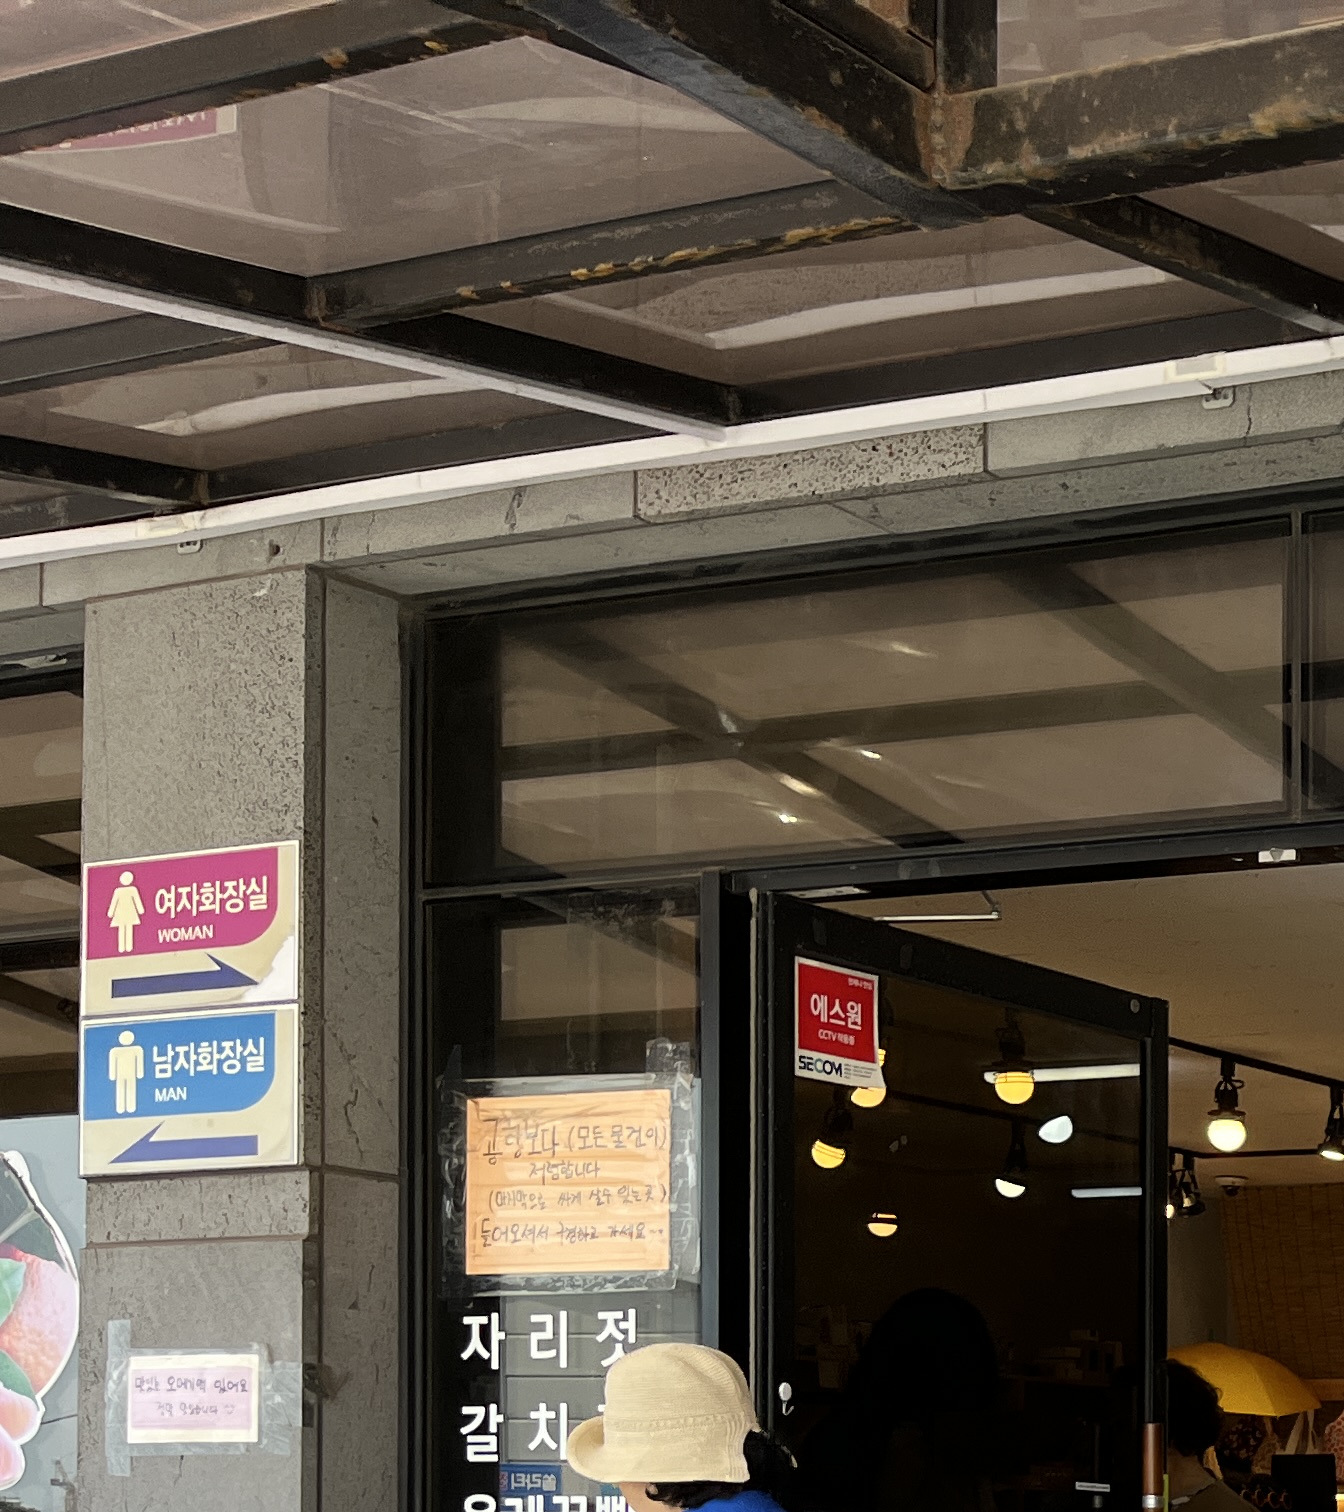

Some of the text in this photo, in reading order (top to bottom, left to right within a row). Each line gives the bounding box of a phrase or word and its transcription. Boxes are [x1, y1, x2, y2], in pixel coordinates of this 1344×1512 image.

[155, 876, 268, 919] 여자화장실
[158, 925, 214, 943] WOMAN
[810, 993, 862, 1031] 에스원
[153, 1037, 265, 1078] 남자화장실
[798, 1055, 843, 1078] SECOM
[155, 1087, 187, 1102] MAN
